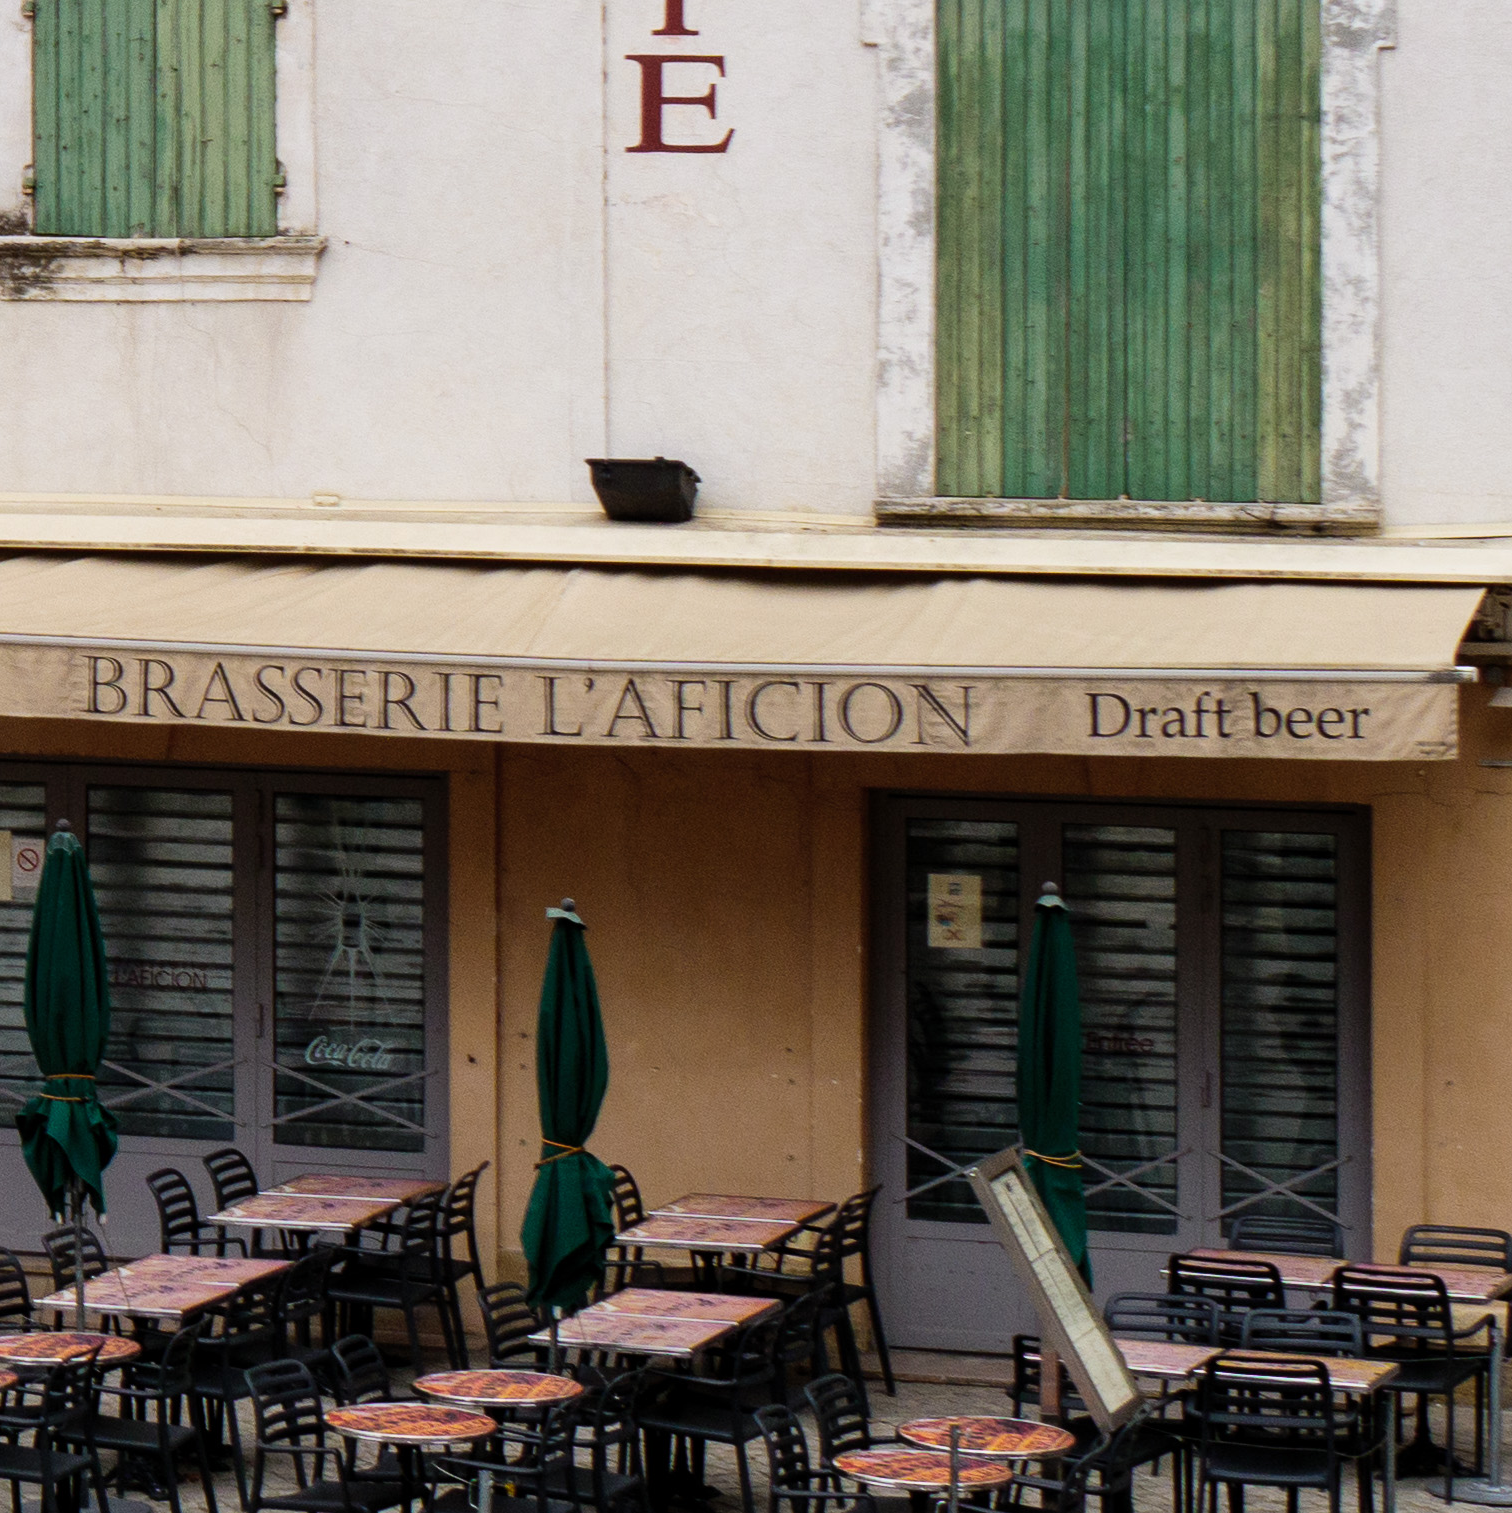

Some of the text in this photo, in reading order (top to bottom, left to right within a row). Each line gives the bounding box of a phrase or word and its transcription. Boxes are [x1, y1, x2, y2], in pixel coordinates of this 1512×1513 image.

[79, 654, 505, 735] BRASSERIE
[535, 674, 978, 748] L'AFICION
[1084, 690, 1233, 739] Draft
[1248, 690, 1371, 740] beer
[304, 1035, 395, 1069] Coca-Cola
